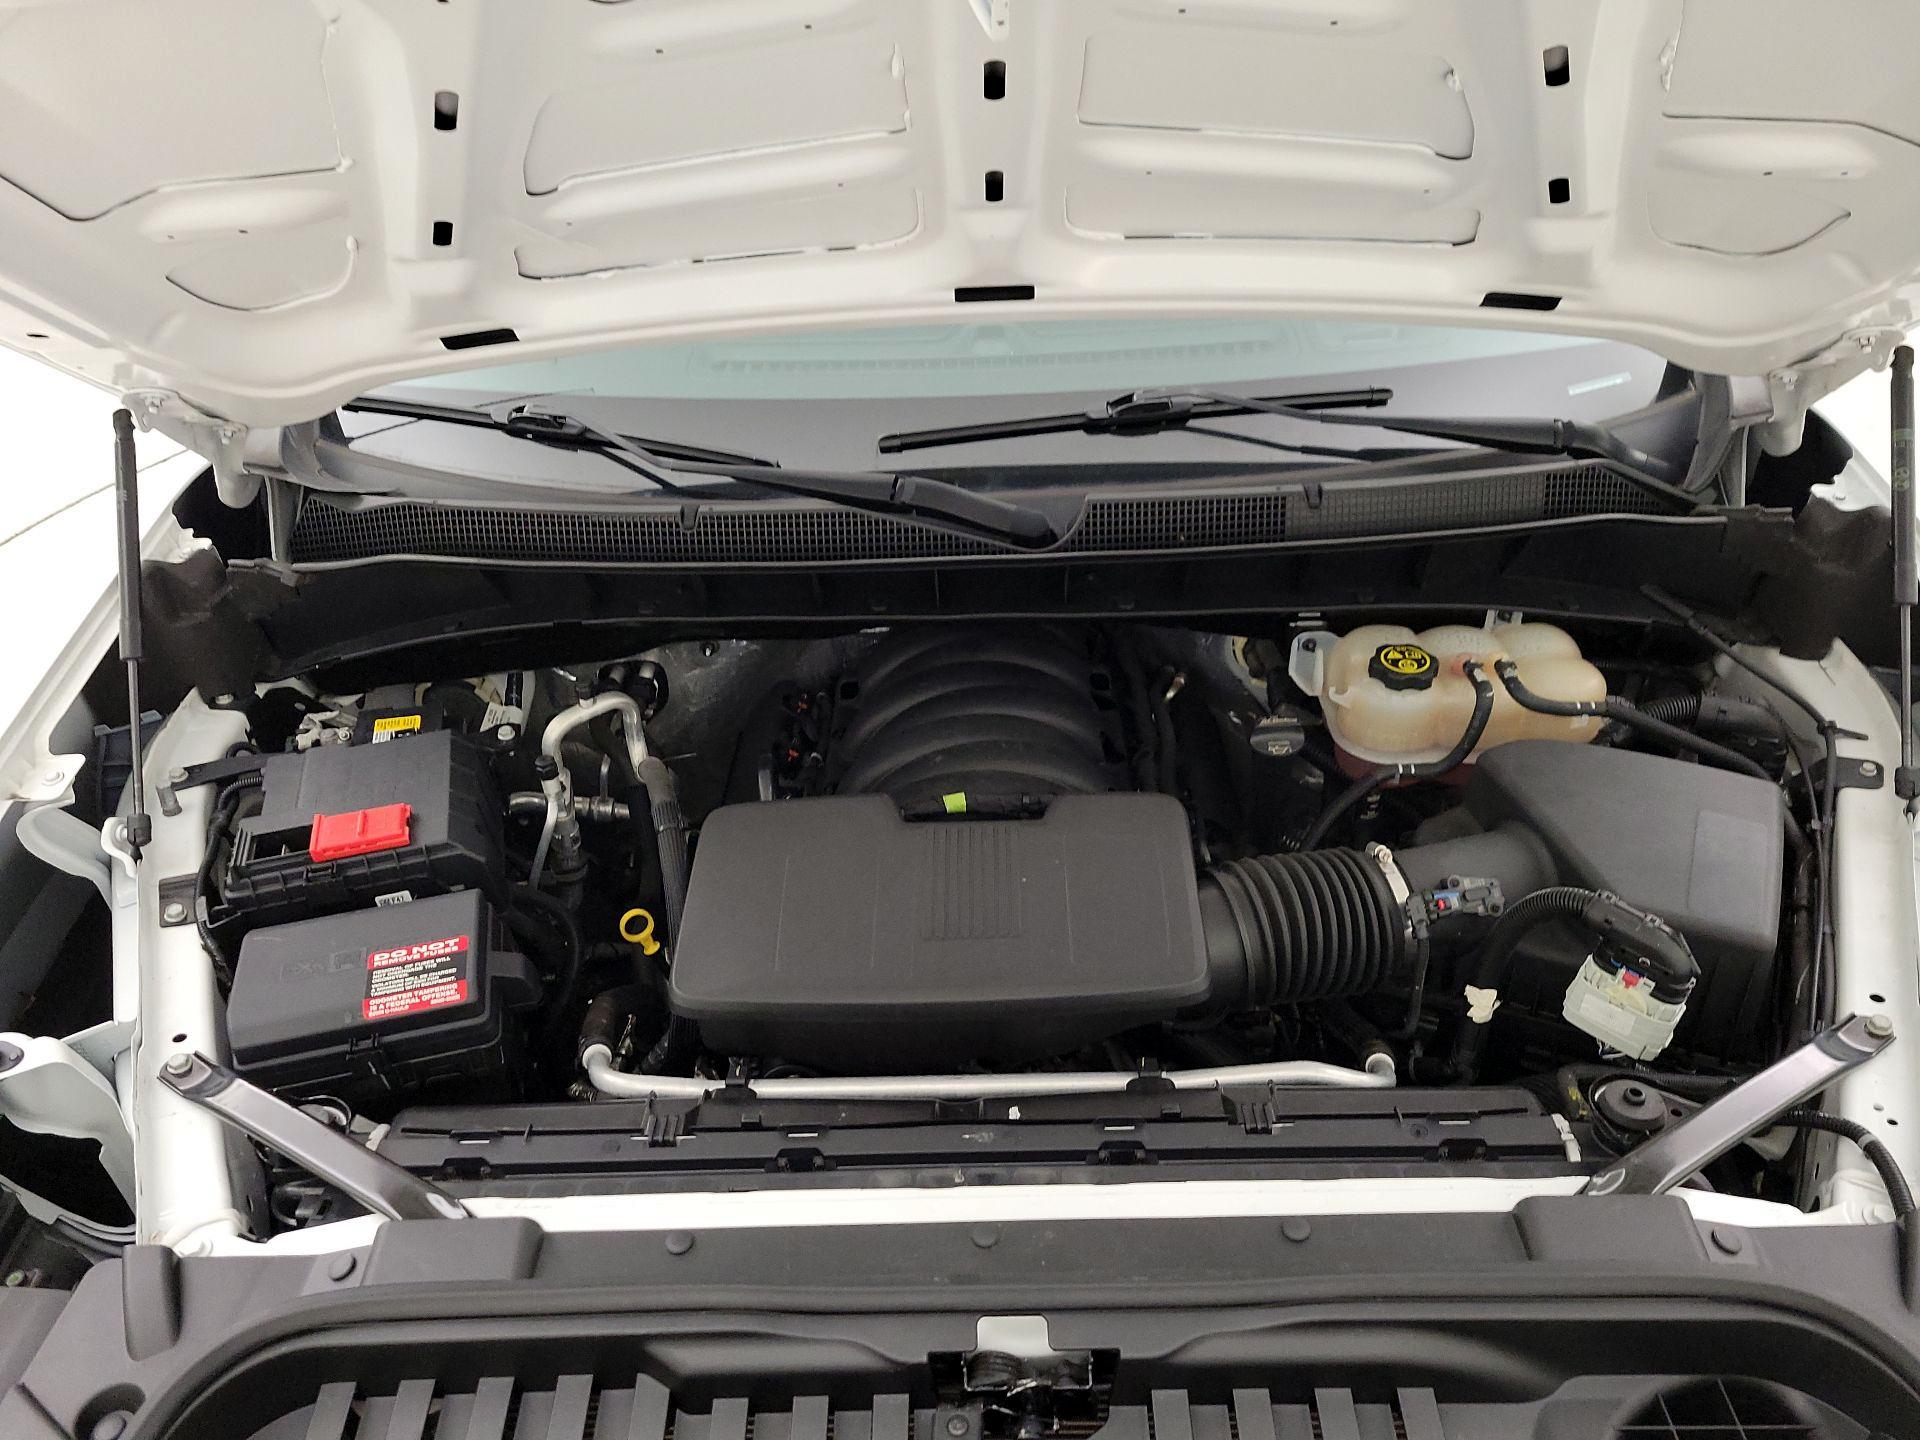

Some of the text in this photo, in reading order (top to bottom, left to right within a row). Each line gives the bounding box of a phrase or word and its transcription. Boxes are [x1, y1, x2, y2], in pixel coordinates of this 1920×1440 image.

[374, 939, 459, 961] DO NOT
[374, 946, 459, 966] REMOVE FUSES
[369, 983, 458, 1005] ODOMETER TAMPERING
[385, 997, 421, 1008] FEDERAL
